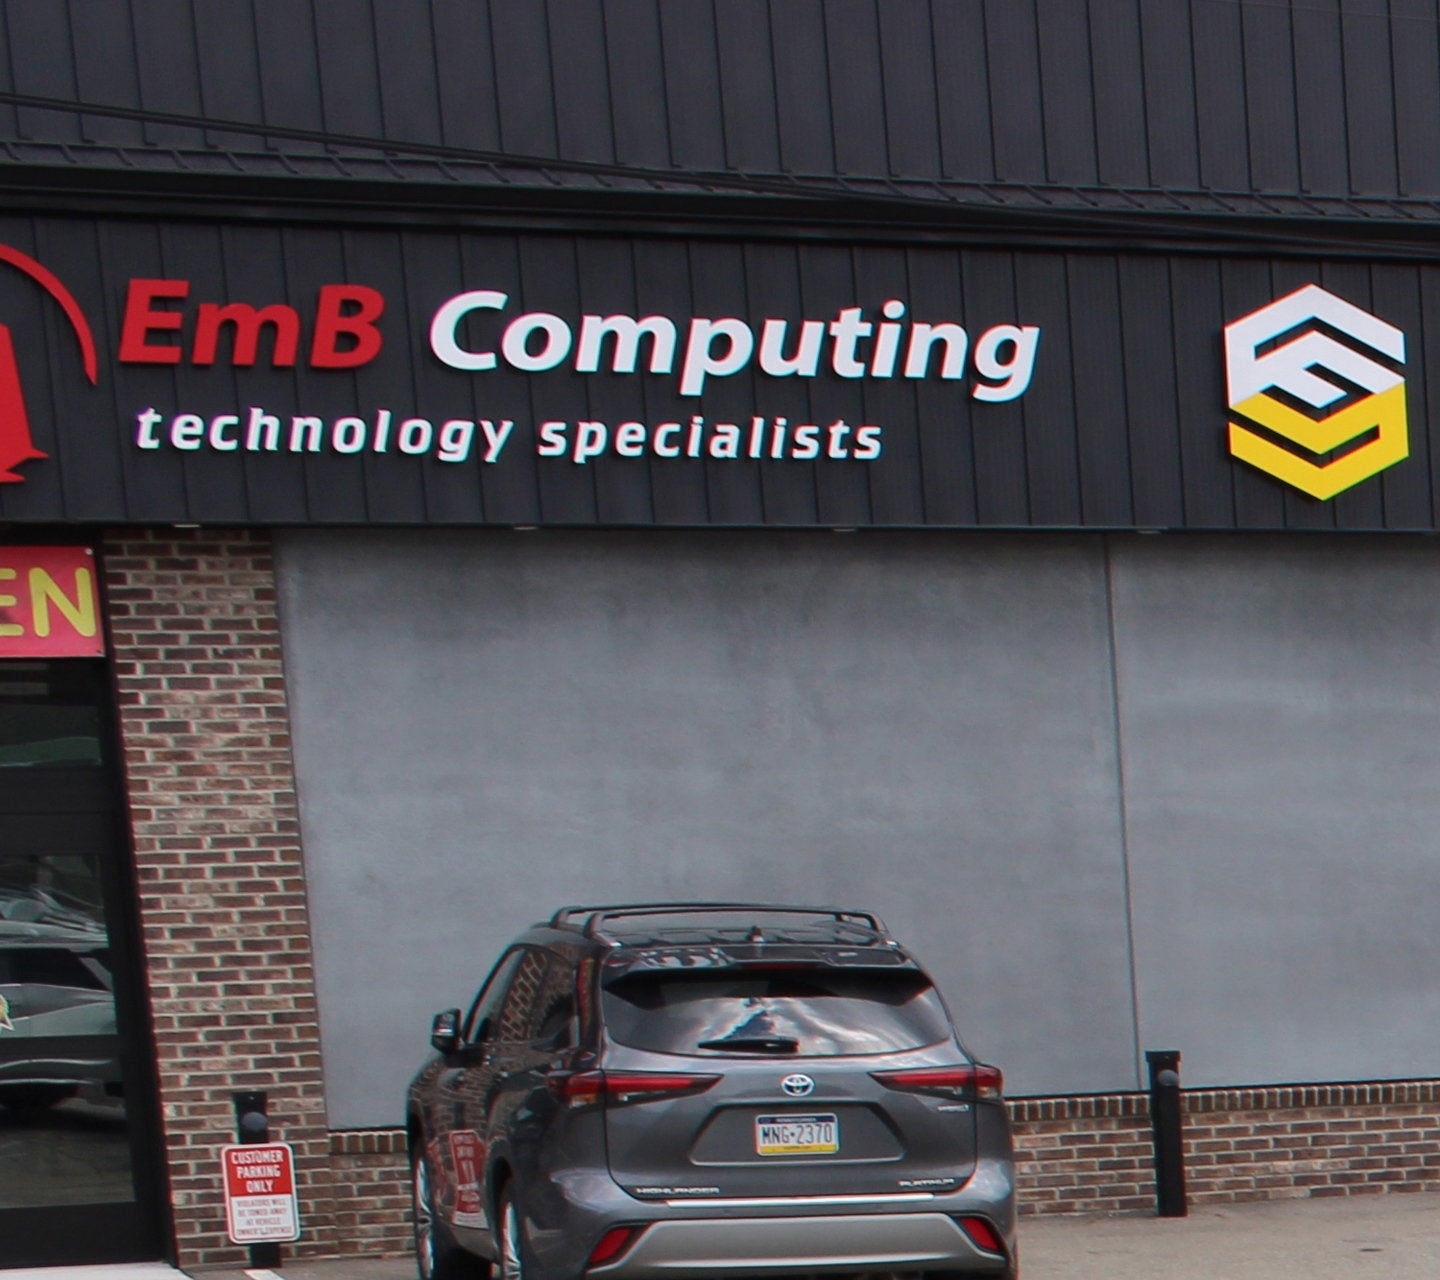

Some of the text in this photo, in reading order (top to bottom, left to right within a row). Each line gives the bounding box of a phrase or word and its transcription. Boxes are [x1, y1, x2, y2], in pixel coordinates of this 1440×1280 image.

[118, 278, 1039, 401] EmB Computing
[137, 408, 881, 463] technology specialists
[231, 1150, 283, 1165] CUSTOMER
[236, 1165, 281, 1179] PARKING
[246, 1180, 273, 1193] ONLY
